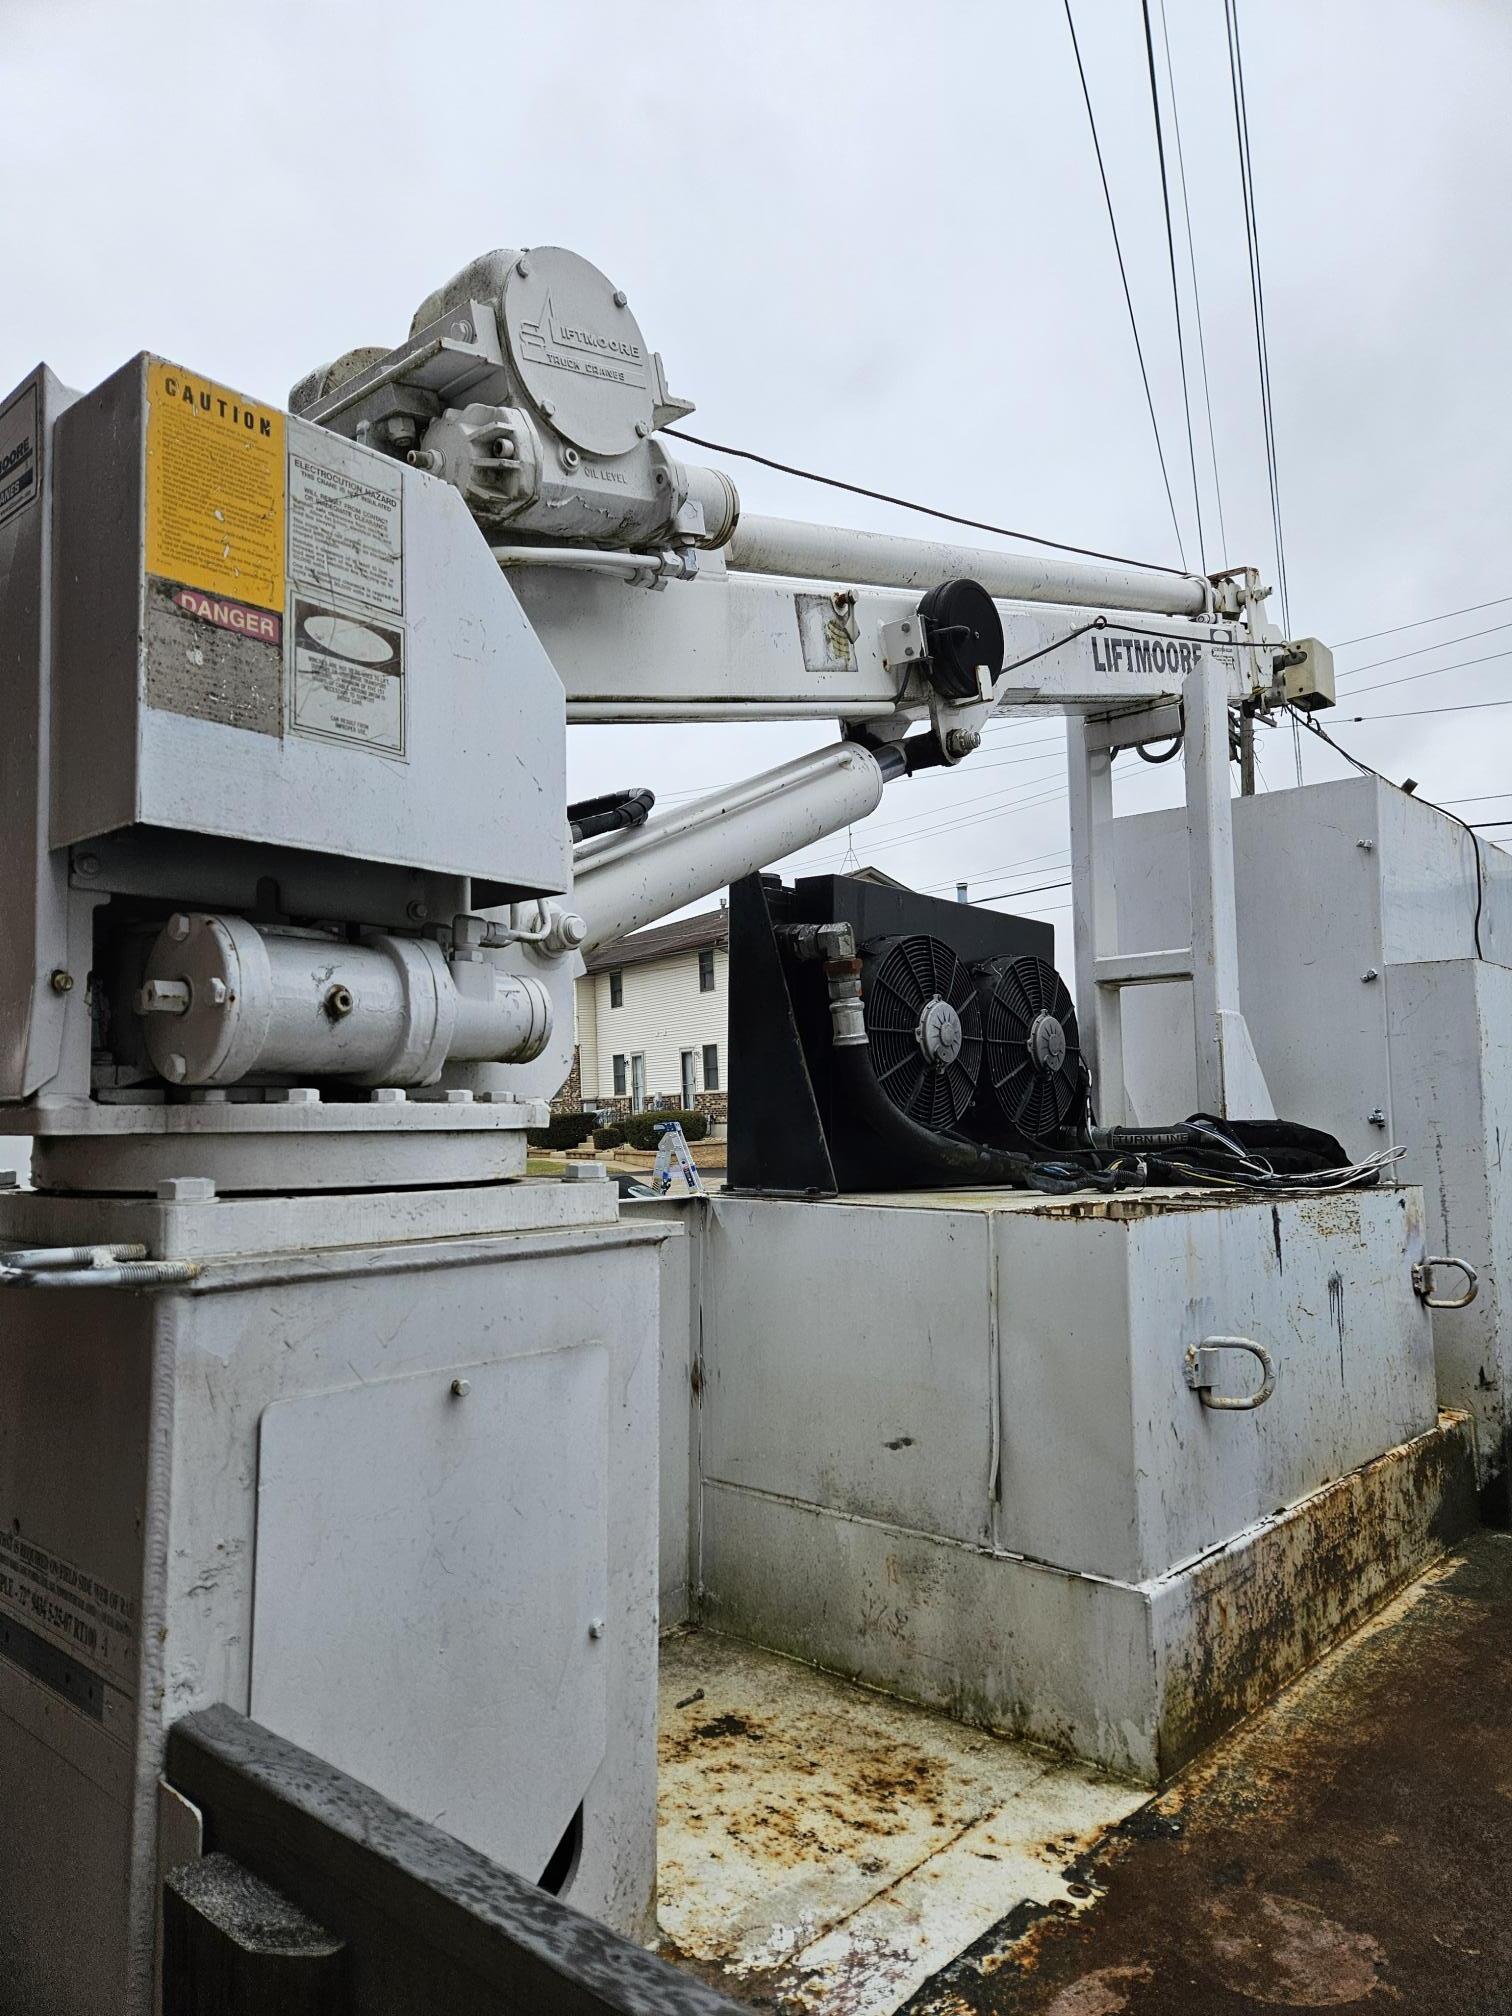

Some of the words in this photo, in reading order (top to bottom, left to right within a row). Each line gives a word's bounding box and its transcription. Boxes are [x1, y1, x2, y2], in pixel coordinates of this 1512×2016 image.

[546, 353, 580, 371] TRUCK
[585, 363, 625, 382] CRANES
[164, 376, 273, 438] CAUTION
[294, 458, 362, 493] ELECTROCUTION
[365, 487, 396, 508] HAZARD
[301, 470, 314, 481] THIS
[316, 476, 336, 490] CRANE
[361, 494, 391, 512] INSULATED
[584, 466, 599, 480] OIL
[601, 469, 628, 484] LEVEL
[304, 487, 317, 498] WILL
[343, 502, 360, 514] FROM
[363, 510, 388, 525] CONTACT
[180, 593, 274, 638] DANGER
[1091, 636, 1202, 675] LIFTMOORE
[1158, 1132, 1188, 1144] LINE
